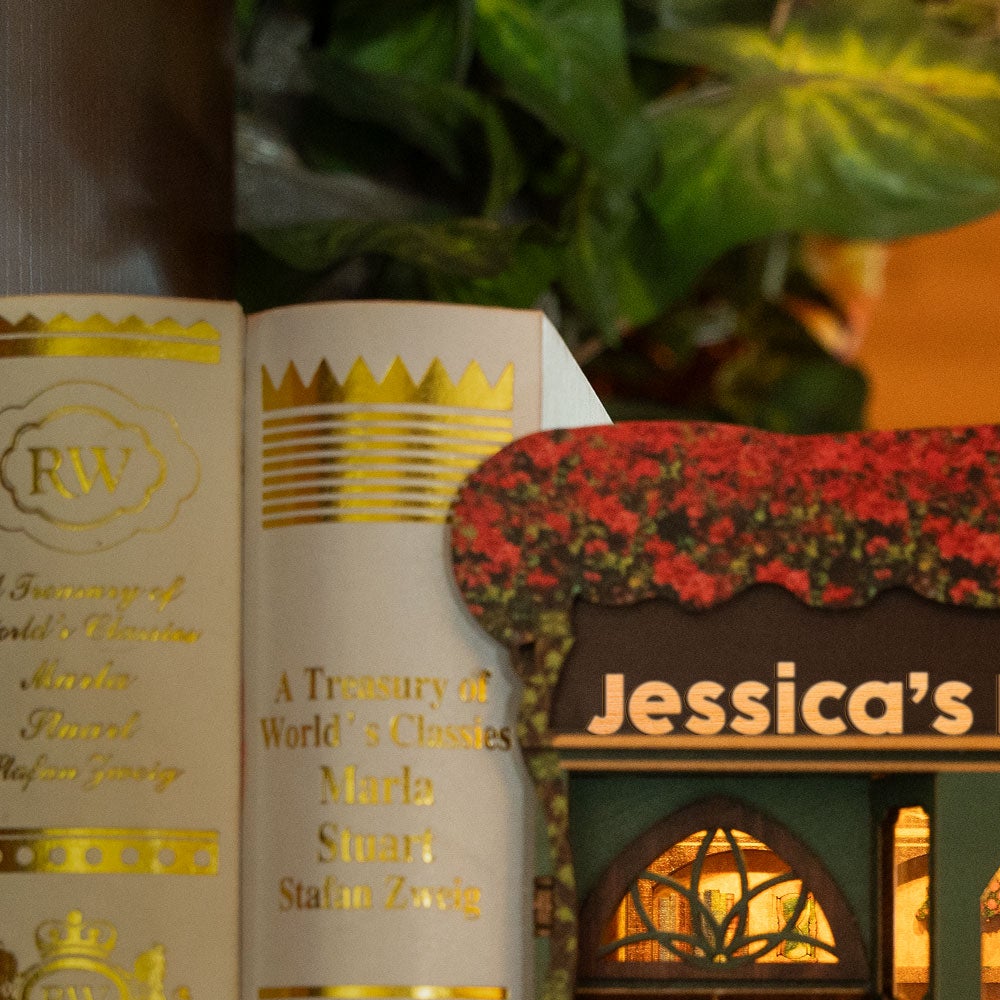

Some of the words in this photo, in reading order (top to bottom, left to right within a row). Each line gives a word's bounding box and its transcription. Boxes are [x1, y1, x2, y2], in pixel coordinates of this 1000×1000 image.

[28, 445, 133, 499] RW
[275, 671, 293, 703] A
[304, 667, 449, 710] Treasury
[458, 669, 491, 703] of
[588, 661, 974, 735] Jessica's
[320, 764, 434, 806] Marla
[317, 821, 435, 864] Stuart
[279, 875, 373, 911] Stafan
[383, 874, 481, 921] Zweig
